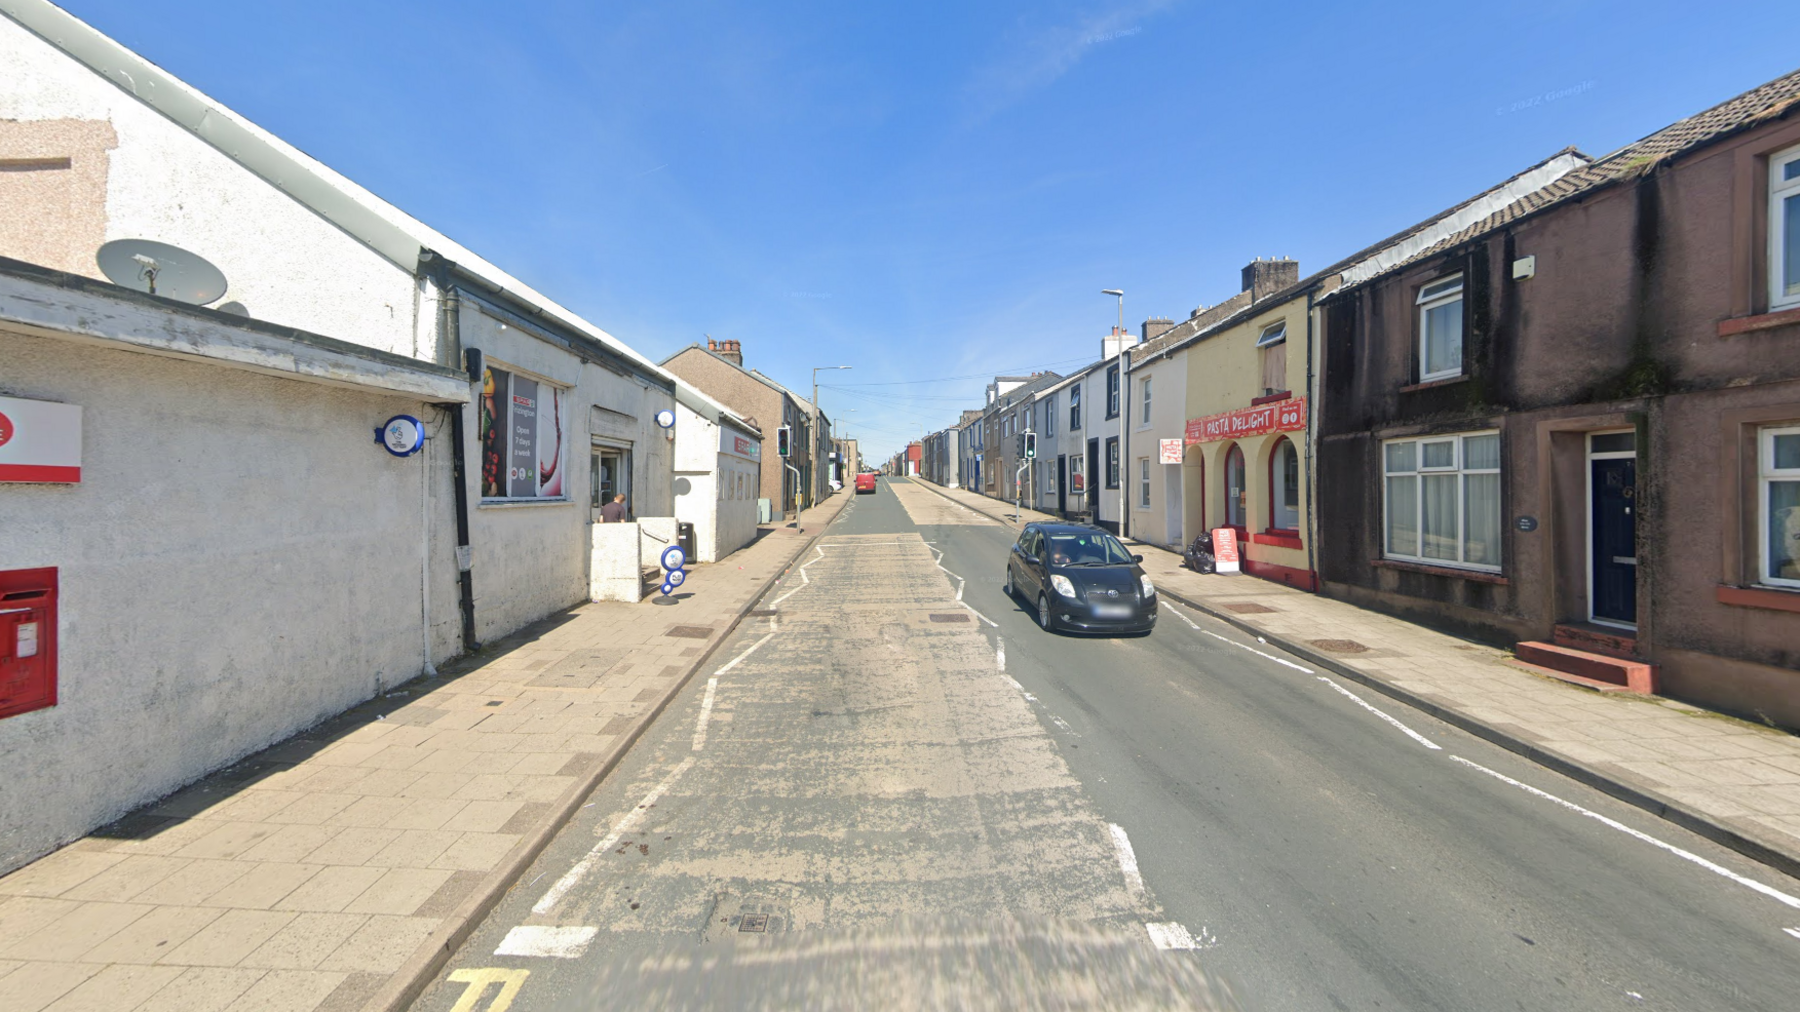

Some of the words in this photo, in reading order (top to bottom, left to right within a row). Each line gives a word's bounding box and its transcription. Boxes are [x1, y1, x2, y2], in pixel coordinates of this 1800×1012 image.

[514, 404, 535, 418] rizington
[1207, 417, 1229, 434] PASTA
[1232, 410, 1270, 431] DELIGHT
[516, 425, 530, 435] Open
[519, 438, 531, 447] days
[519, 449, 531, 457] week
